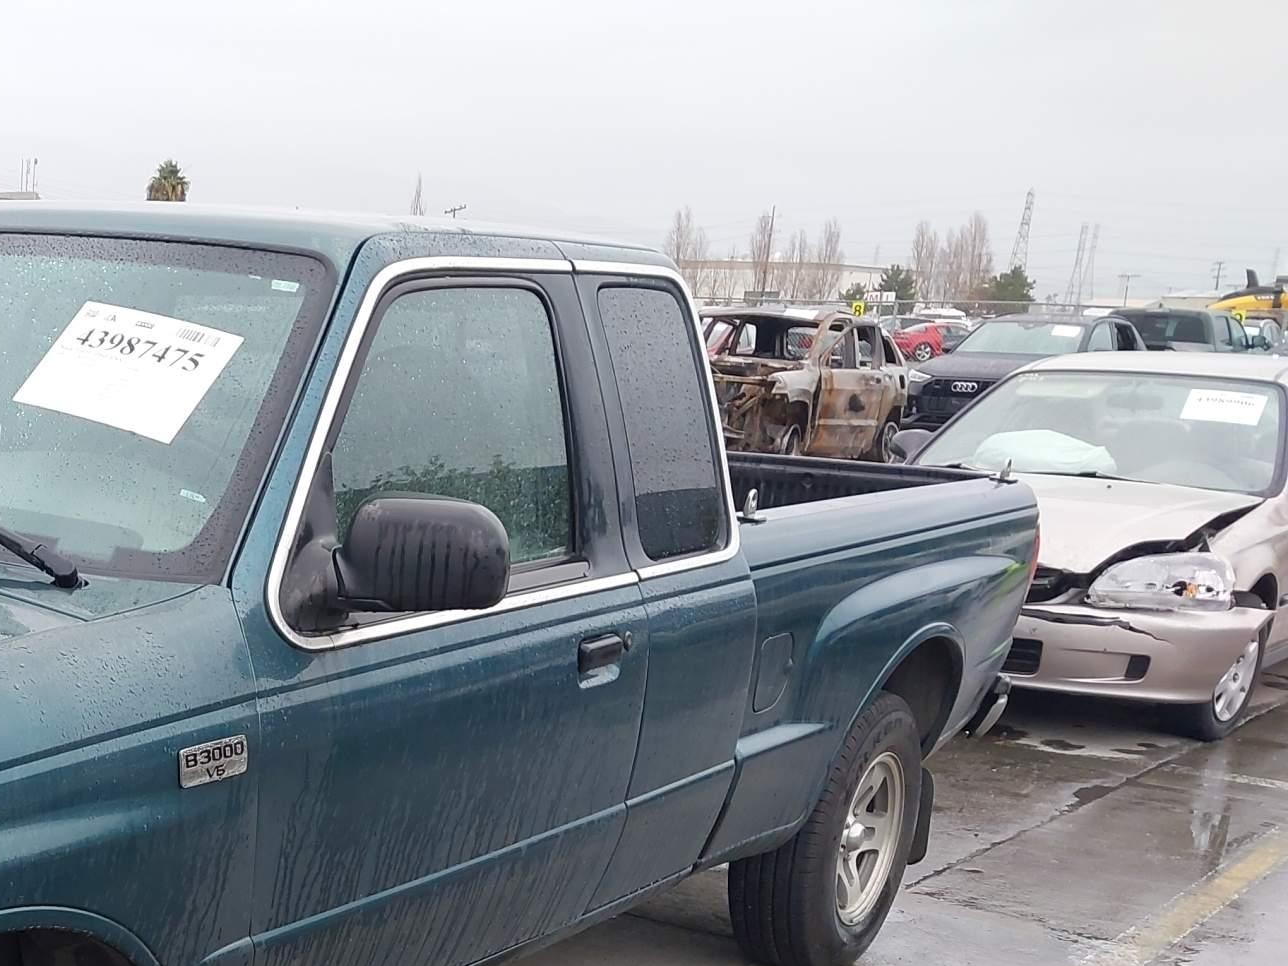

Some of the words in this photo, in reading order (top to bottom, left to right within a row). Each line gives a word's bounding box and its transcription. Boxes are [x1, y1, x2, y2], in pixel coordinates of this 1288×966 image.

[76, 328, 206, 372] 43987475
[185, 741, 244, 769] B3000
[206, 764, 226, 778] V6
